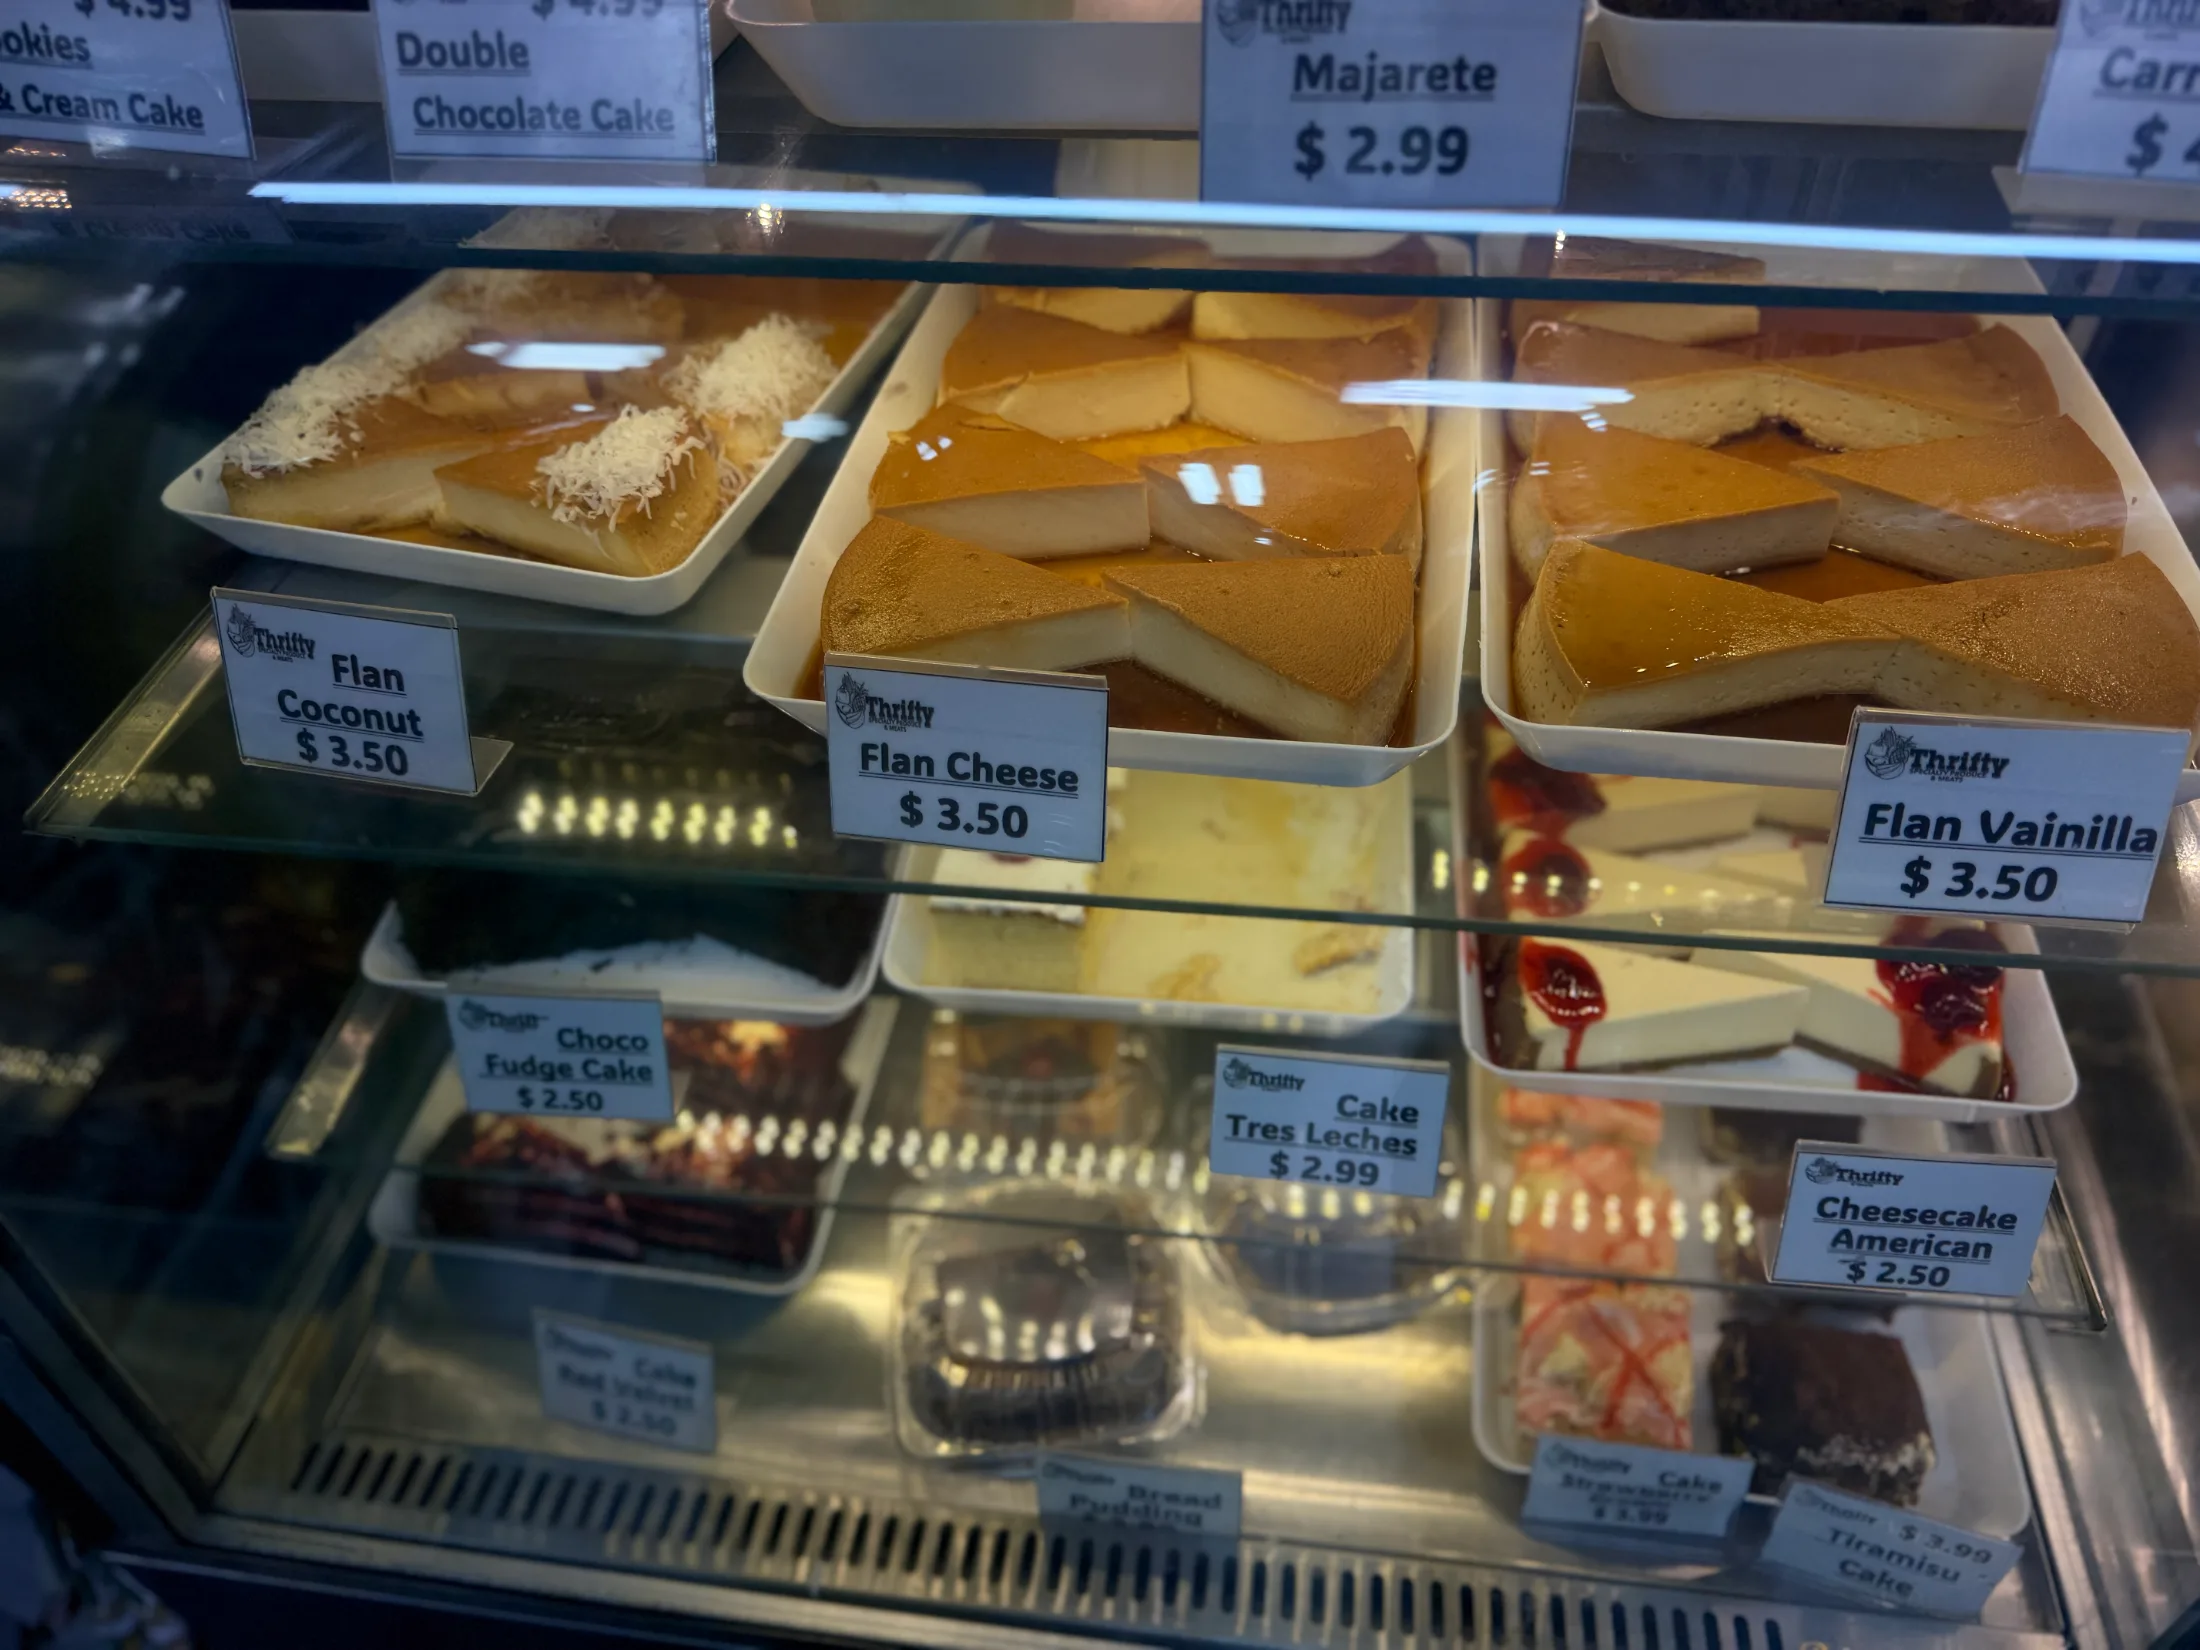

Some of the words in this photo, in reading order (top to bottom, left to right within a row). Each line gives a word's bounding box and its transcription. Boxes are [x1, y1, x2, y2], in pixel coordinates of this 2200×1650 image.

[0, 21, 92, 63] okies
[395, 29, 531, 69] Double
[1292, 50, 1499, 102] Majarete
[21, 83, 121, 122] Cream
[128, 92, 206, 129] Cake
[413, 94, 582, 131] Chocolate
[590, 97, 676, 133] Cake
[1293, 120, 1326, 182] $
[1344, 125, 1471, 176] 2.99
[2124, 112, 2170, 179] $
[252, 627, 316, 661] Thrifty
[331, 653, 405, 693] Flan
[277, 688, 425, 738] Coconut
[864, 696, 935, 729] Thrifty
[296, 727, 319, 764] $
[328, 734, 409, 777] 3.50
[859, 742, 935, 778] Flan
[946, 751, 1079, 793] Cheese
[1909, 748, 2010, 779] Thrifty
[899, 790, 924, 828] $
[937, 797, 1029, 839] 3.50
[1863, 802, 1963, 842] Flan
[1979, 810, 2158, 854] Vainilla
[1899, 855, 1932, 899] $
[1944, 861, 2059, 903] 3.50
[556, 1026, 650, 1052] Choco
[484, 1053, 574, 1082] Fudge
[581, 1058, 654, 1083] Cake
[517, 1084, 535, 1109] $
[542, 1088, 604, 1112] 2.50
[1336, 1093, 1420, 1124] Cake
[1225, 1113, 1295, 1142] Tres
[1305, 1121, 1418, 1156] Leches
[1269, 1149, 1290, 1180] $
[1301, 1155, 1380, 1187] 2.99
[1835, 1168, 1905, 1187] Thrifty
[1815, 1195, 2018, 1231] Cheesecake
[1829, 1227, 1993, 1261] American
[1846, 1260, 1868, 1285] $
[1875, 1261, 1950, 1288] 2.50
[1657, 1470, 1724, 1494] Cake
[1828, 1526, 1962, 1584] Tiramisu
[1898, 1523, 1918, 1544] $
[1923, 1533, 1994, 1565] 3.99
[1837, 1557, 1916, 1599] Cake
